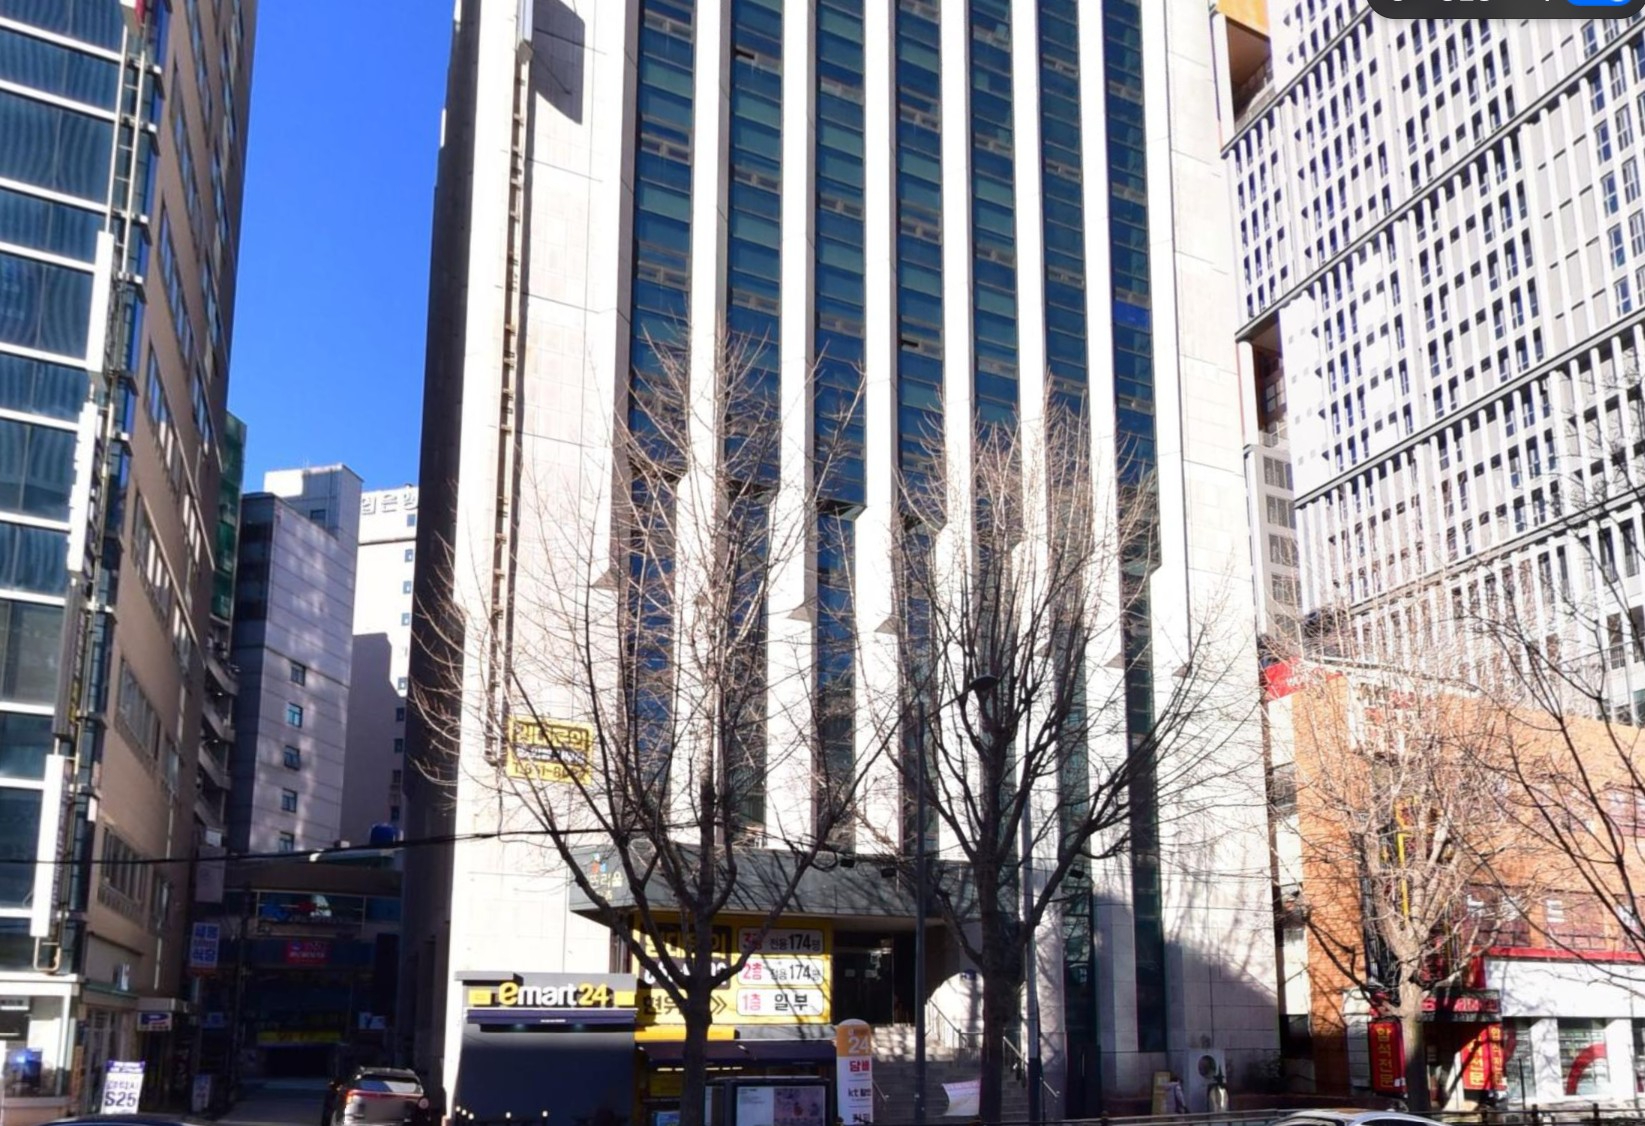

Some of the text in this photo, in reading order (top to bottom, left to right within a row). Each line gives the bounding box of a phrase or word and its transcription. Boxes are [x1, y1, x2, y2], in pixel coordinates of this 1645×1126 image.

[743, 932, 763, 951] 3
[743, 962, 762, 980] 2층
[499, 982, 609, 1006] emart24
[742, 993, 762, 1011] 1층
